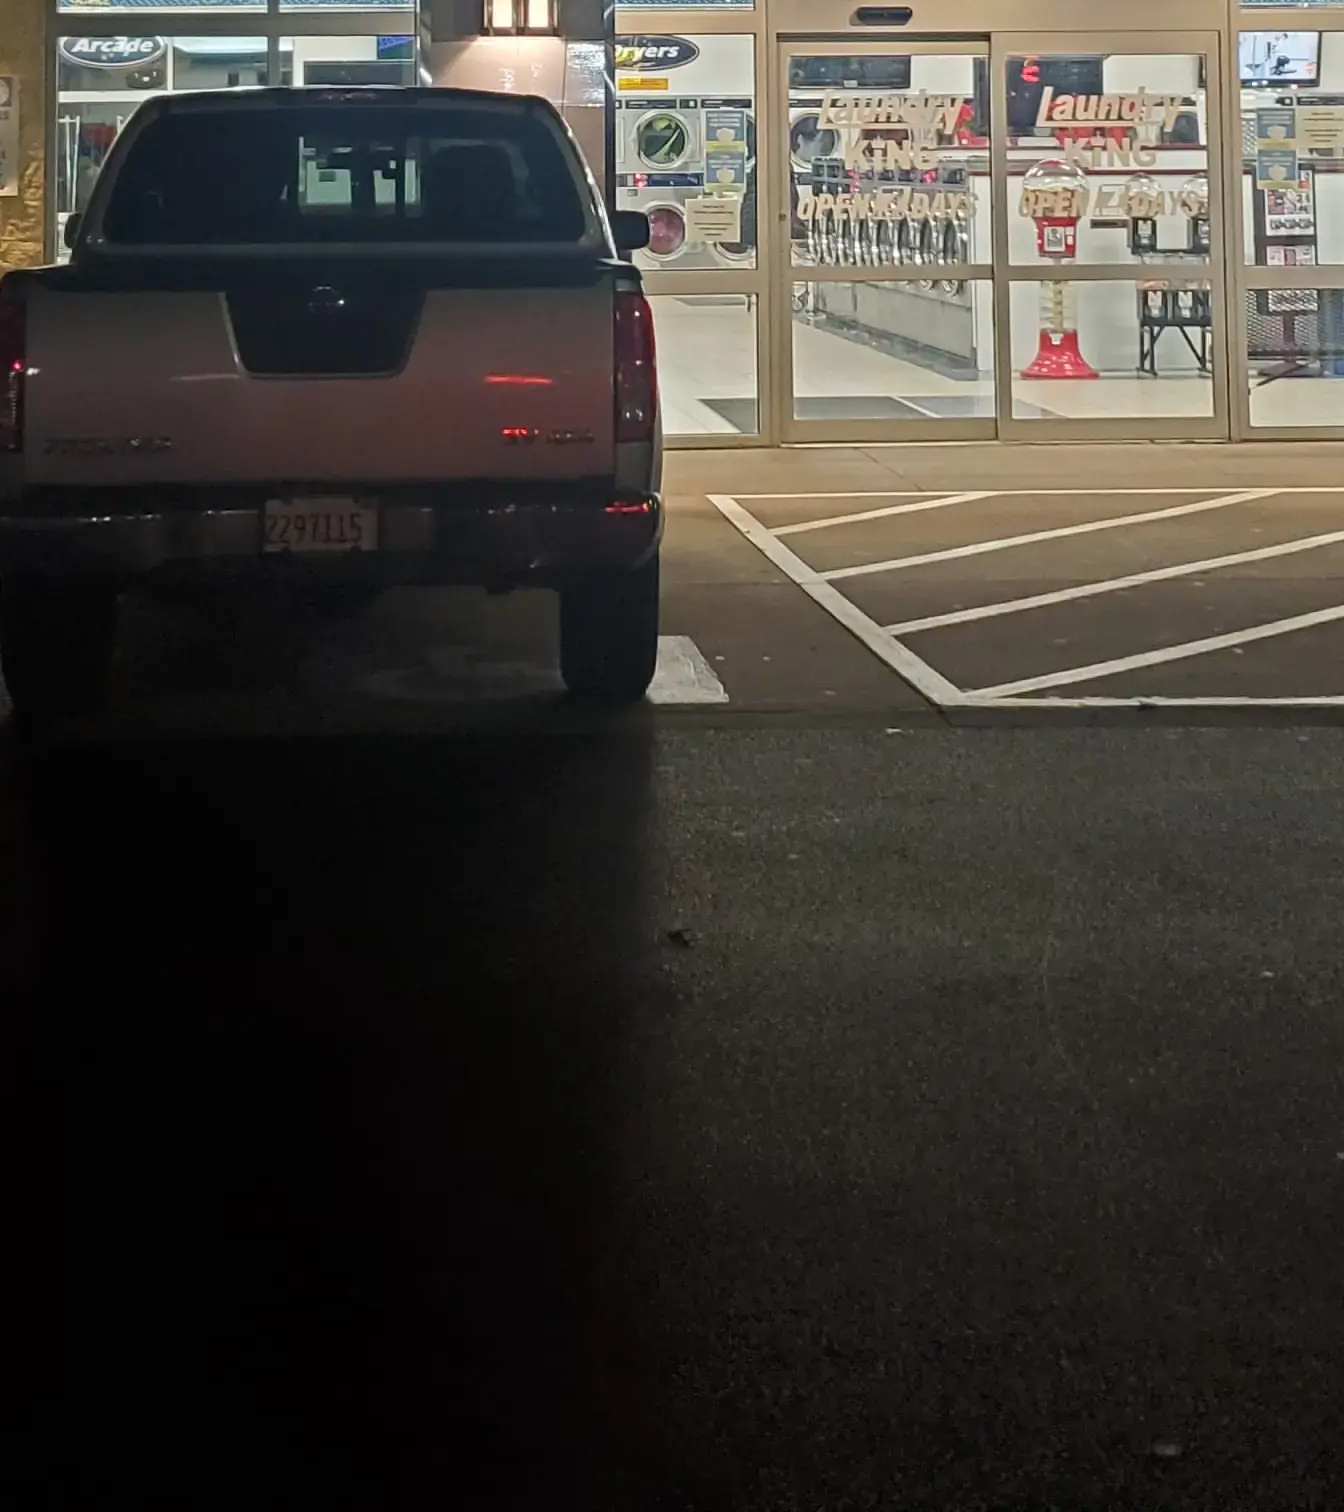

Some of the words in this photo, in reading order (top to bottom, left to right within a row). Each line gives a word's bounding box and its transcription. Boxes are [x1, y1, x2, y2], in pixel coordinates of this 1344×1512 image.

[70, 37, 155, 54] Arcade
[817, 88, 966, 135] Laundry
[1036, 86, 1184, 133] Laundry
[797, 191, 871, 220] OPEN
[1019, 188, 1089, 218] OPEN
[1130, 190, 1208, 218] DAYS
